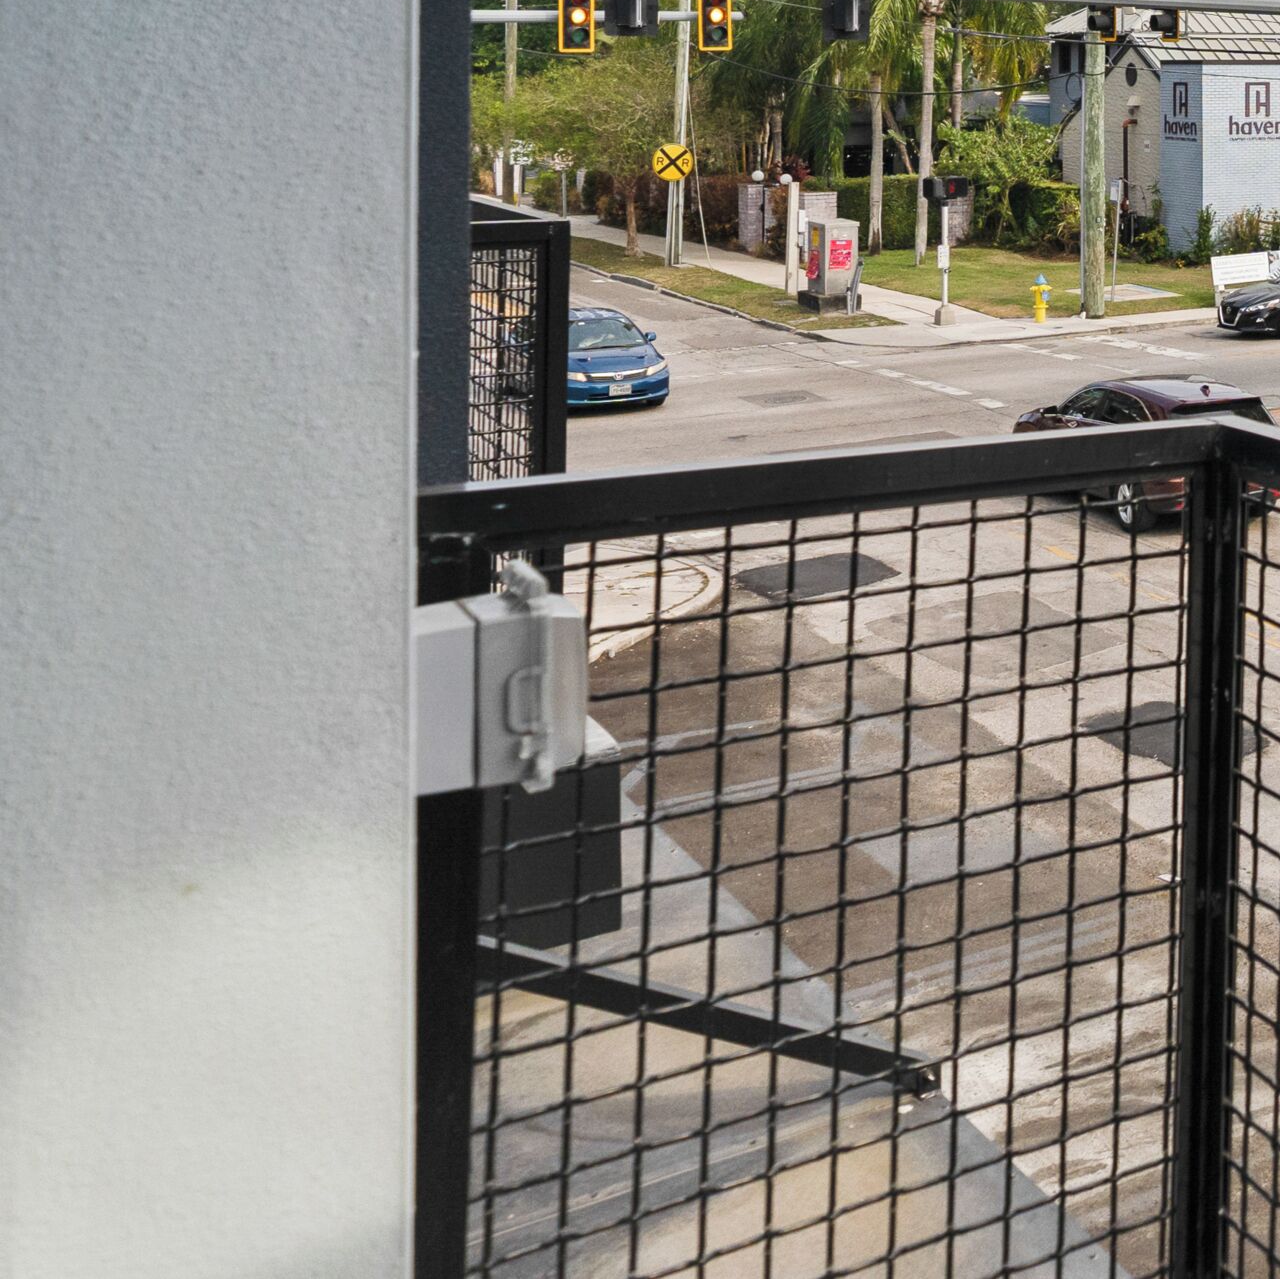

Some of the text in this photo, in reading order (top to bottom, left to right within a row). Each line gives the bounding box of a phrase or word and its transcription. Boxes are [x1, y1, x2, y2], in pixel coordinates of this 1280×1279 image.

[1164, 114, 1198, 136] haven
[656, 156, 690, 168] R R
